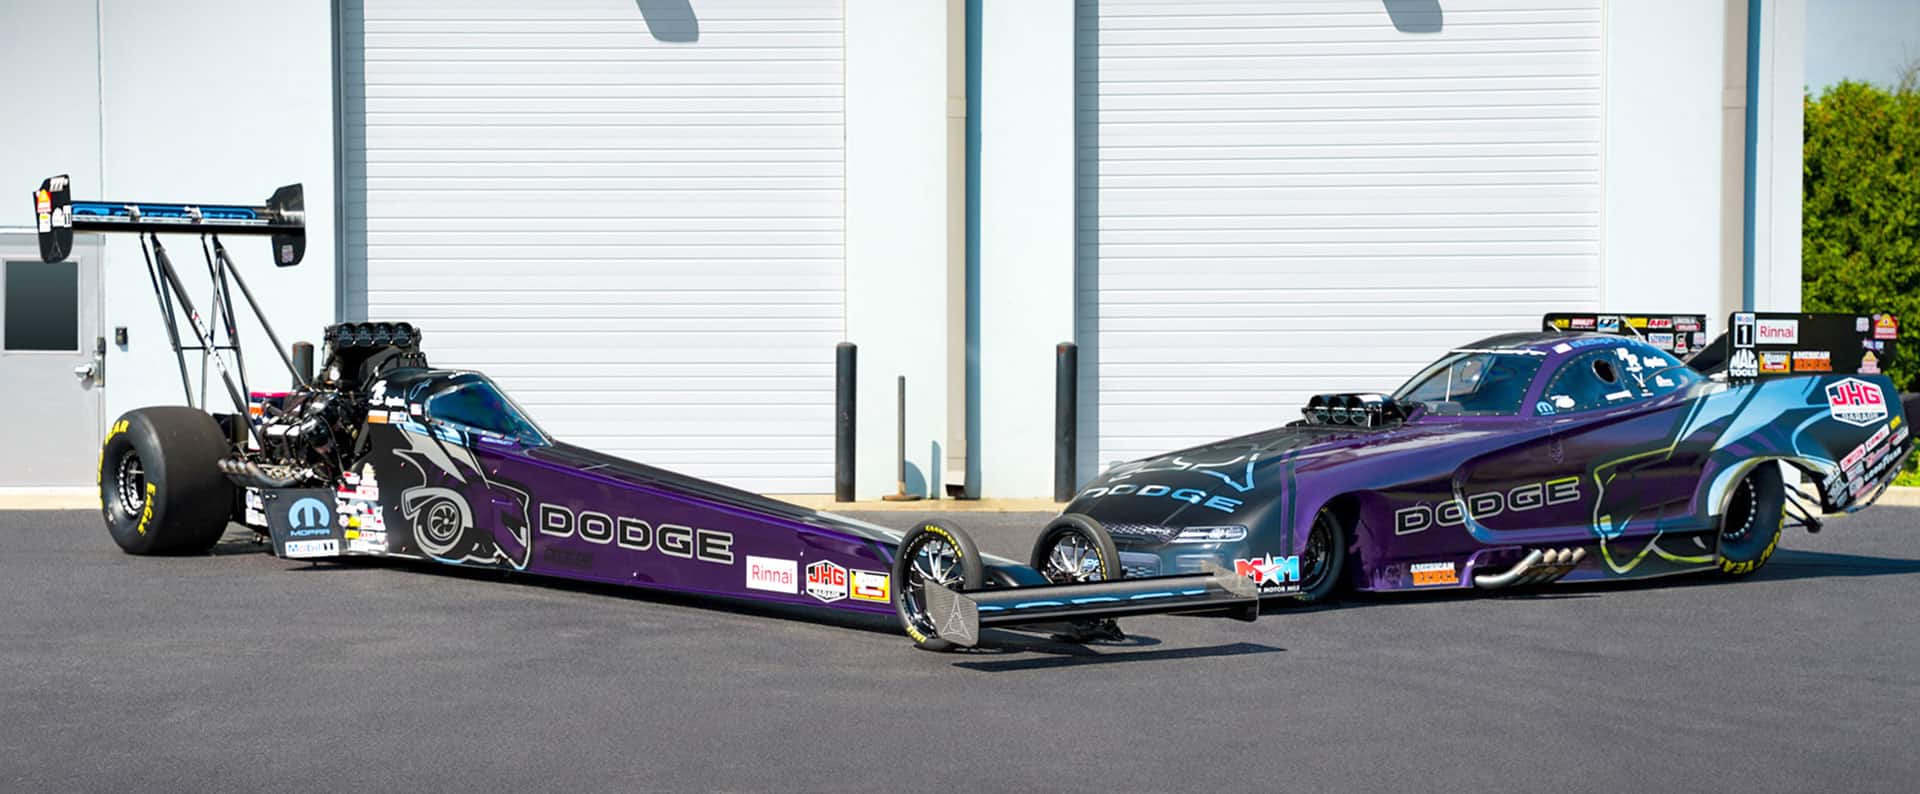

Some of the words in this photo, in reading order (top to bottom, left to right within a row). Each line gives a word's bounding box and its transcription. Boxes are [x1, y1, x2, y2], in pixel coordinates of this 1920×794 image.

[1760, 326, 1794, 337] Rinnai
[1831, 384, 1881, 405] JHG
[137, 482, 156, 535] EAGLE
[1082, 484, 1243, 514] DODGE
[1395, 476, 1580, 535] DODGE
[290, 528, 331, 537] MOPAR
[539, 503, 734, 565] DODGE
[752, 564, 793, 584] Rinnai
[809, 565, 845, 586] JHG
[1410, 562, 1455, 572] AMERICAN
